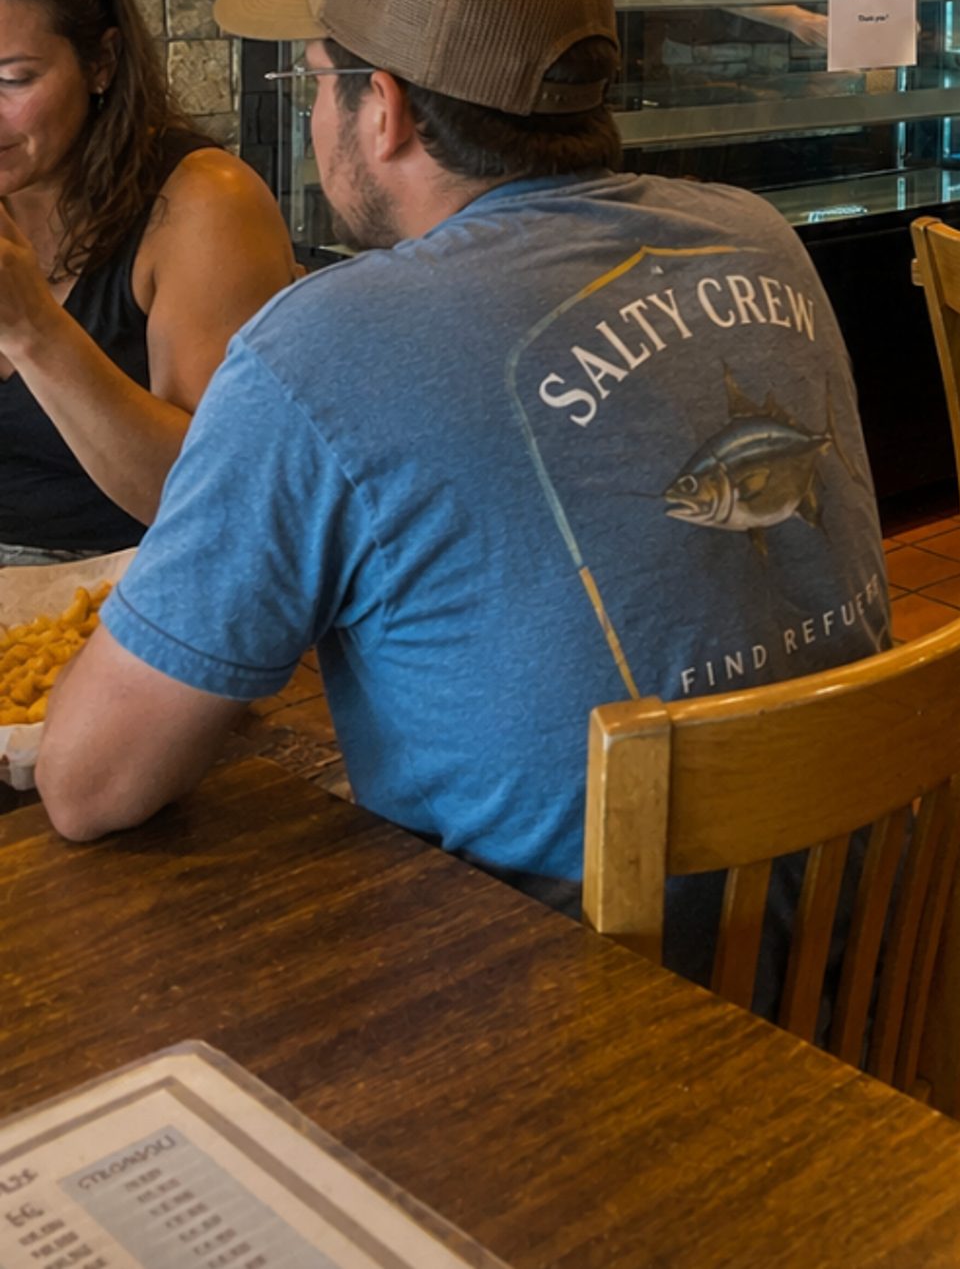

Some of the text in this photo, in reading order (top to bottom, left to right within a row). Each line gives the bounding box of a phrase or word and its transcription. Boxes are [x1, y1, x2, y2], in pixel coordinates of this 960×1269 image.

[537, 274, 818, 428] SALTY CREW
[681, 643, 767, 694] FIND
